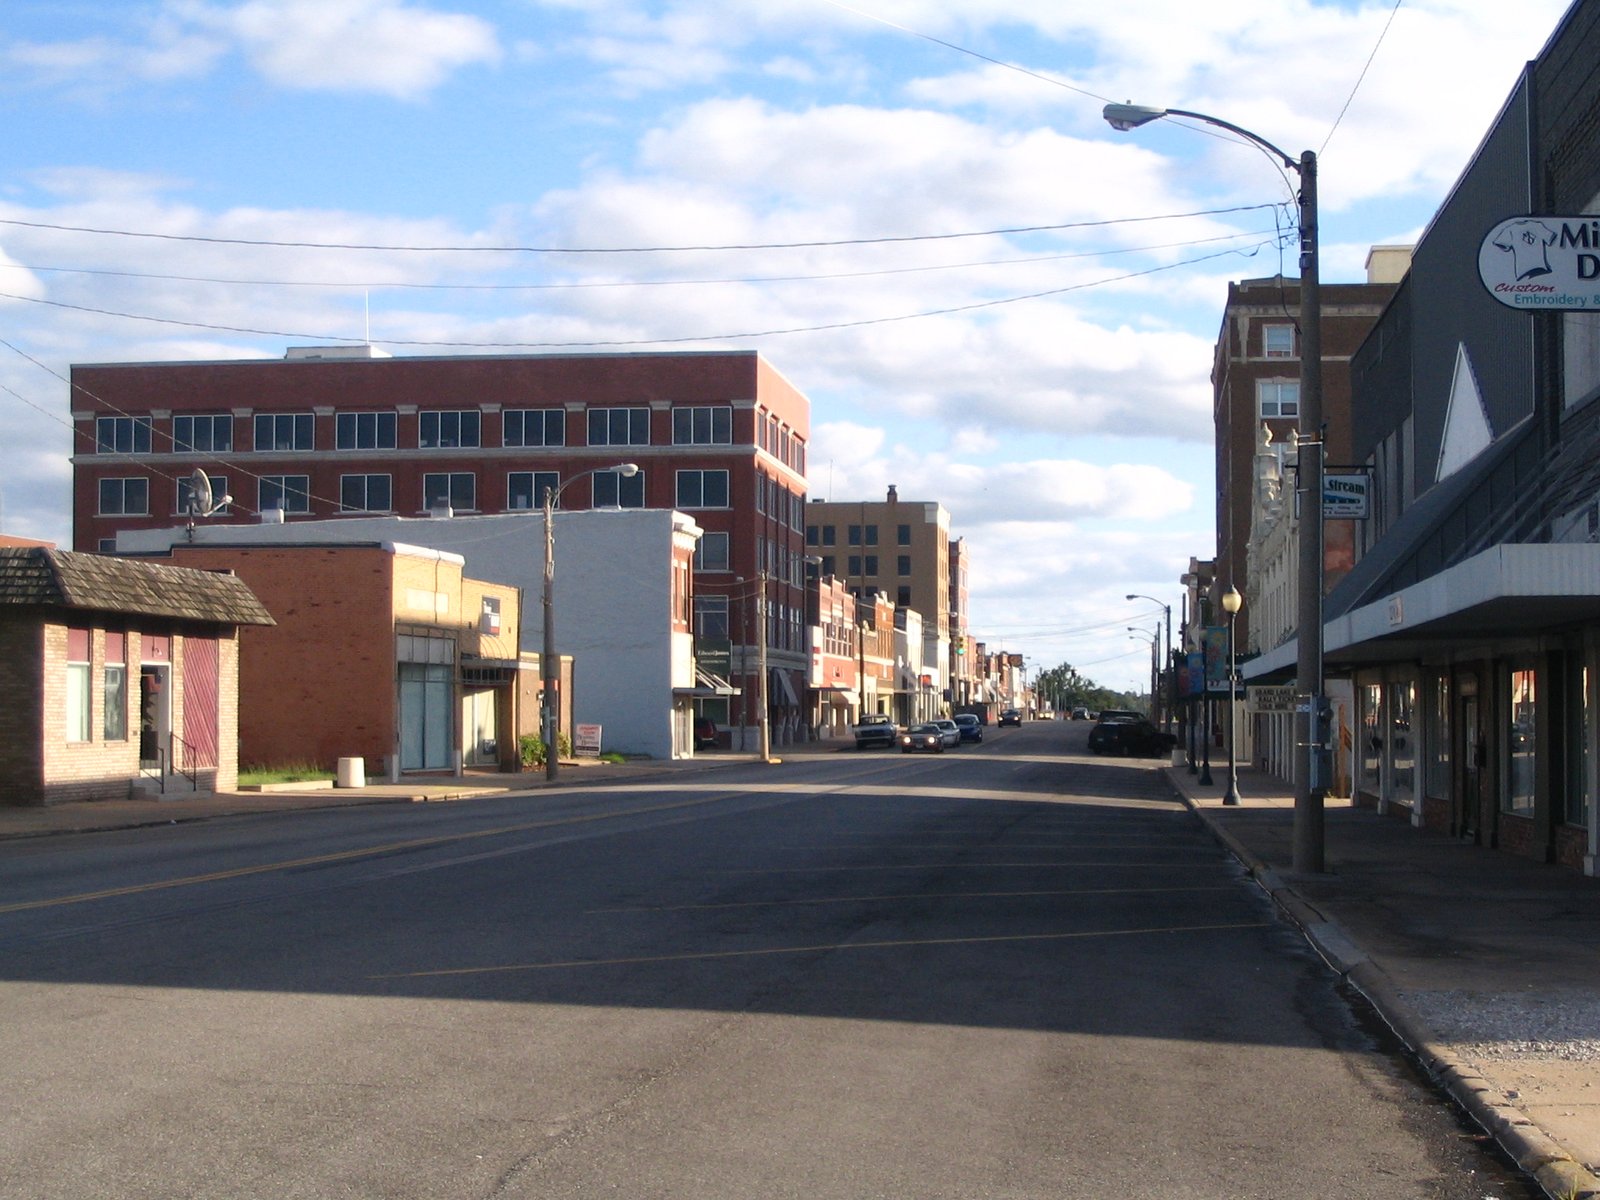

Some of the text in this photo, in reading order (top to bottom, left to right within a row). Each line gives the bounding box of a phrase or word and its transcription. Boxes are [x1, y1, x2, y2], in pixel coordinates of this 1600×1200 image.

[1494, 282, 1555, 293] Custom
[1514, 294, 1588, 307] Embroidery
[1328, 479, 1365, 495] Stream
